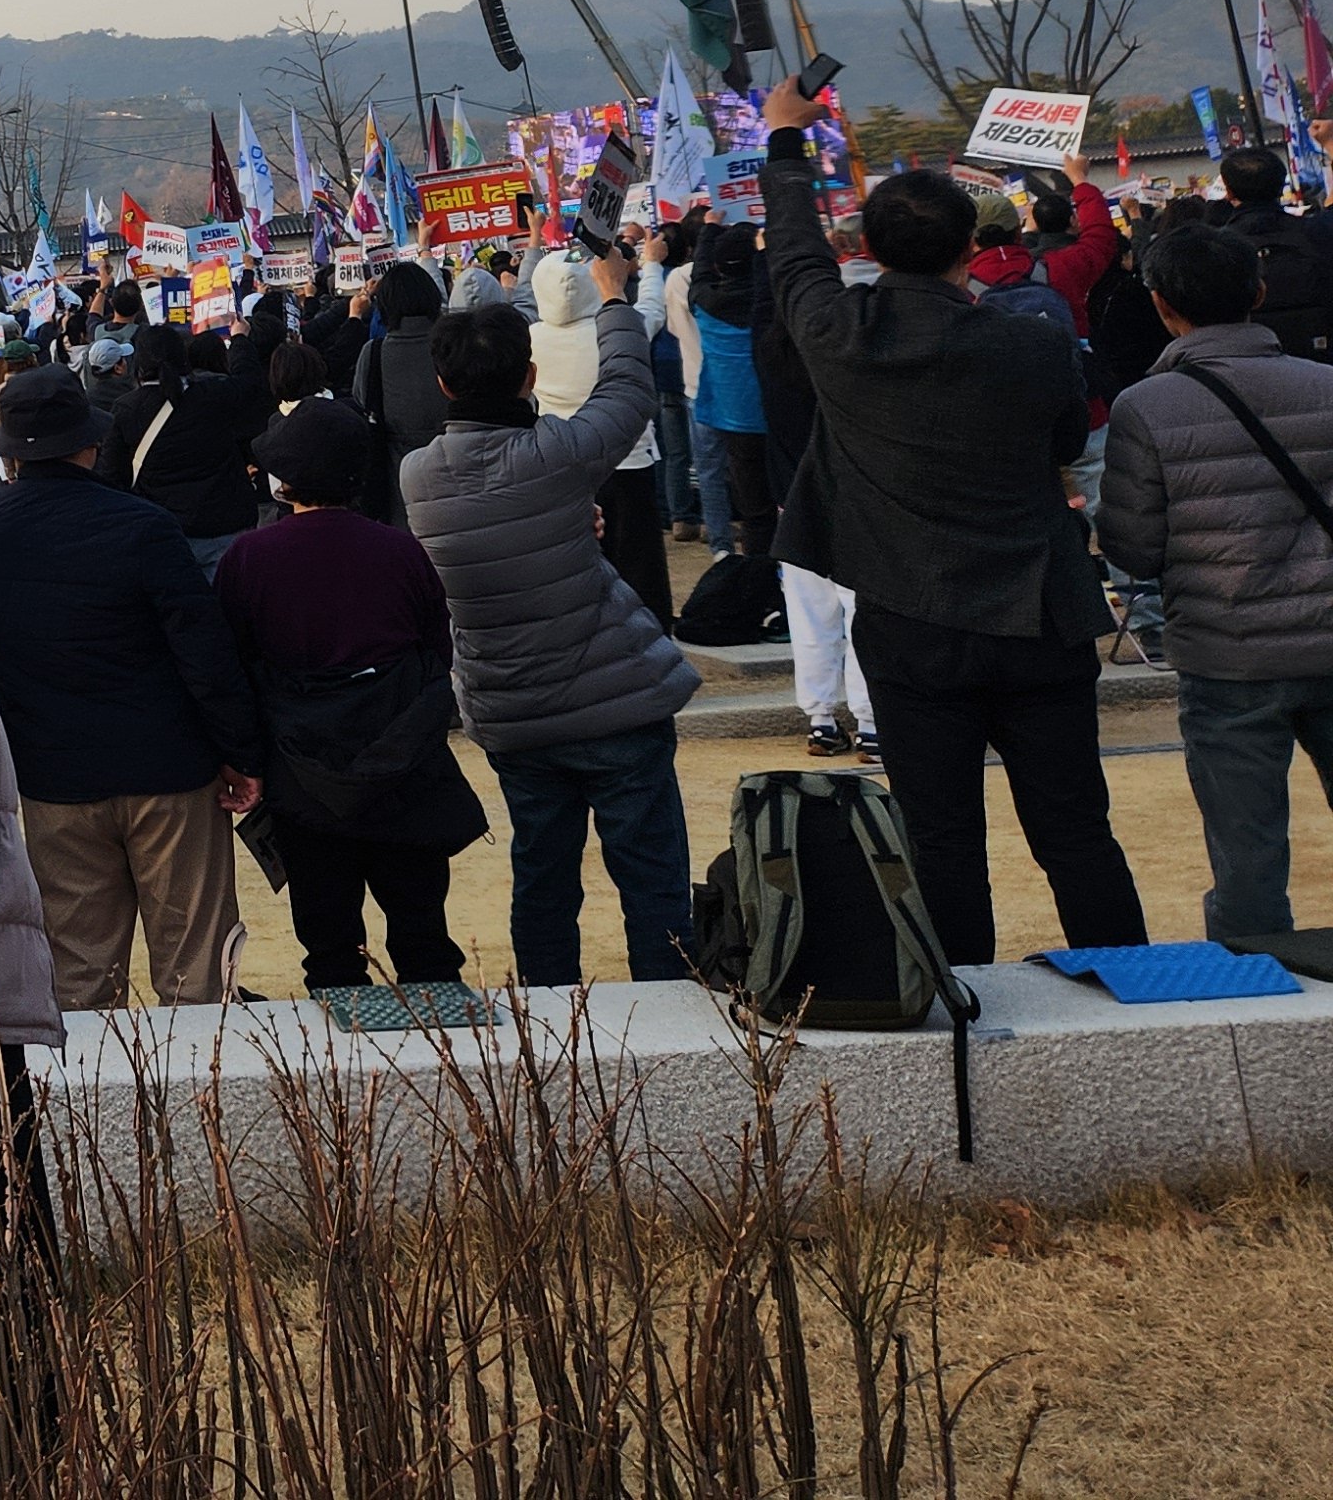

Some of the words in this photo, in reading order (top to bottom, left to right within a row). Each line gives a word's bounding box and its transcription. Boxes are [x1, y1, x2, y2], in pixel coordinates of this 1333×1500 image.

[991, 98, 1082, 126] 내란세력
[977, 122, 1080, 152] 제압하자!
[423, 186, 476, 212] 파면!
[446, 205, 513, 233] 윤석열
